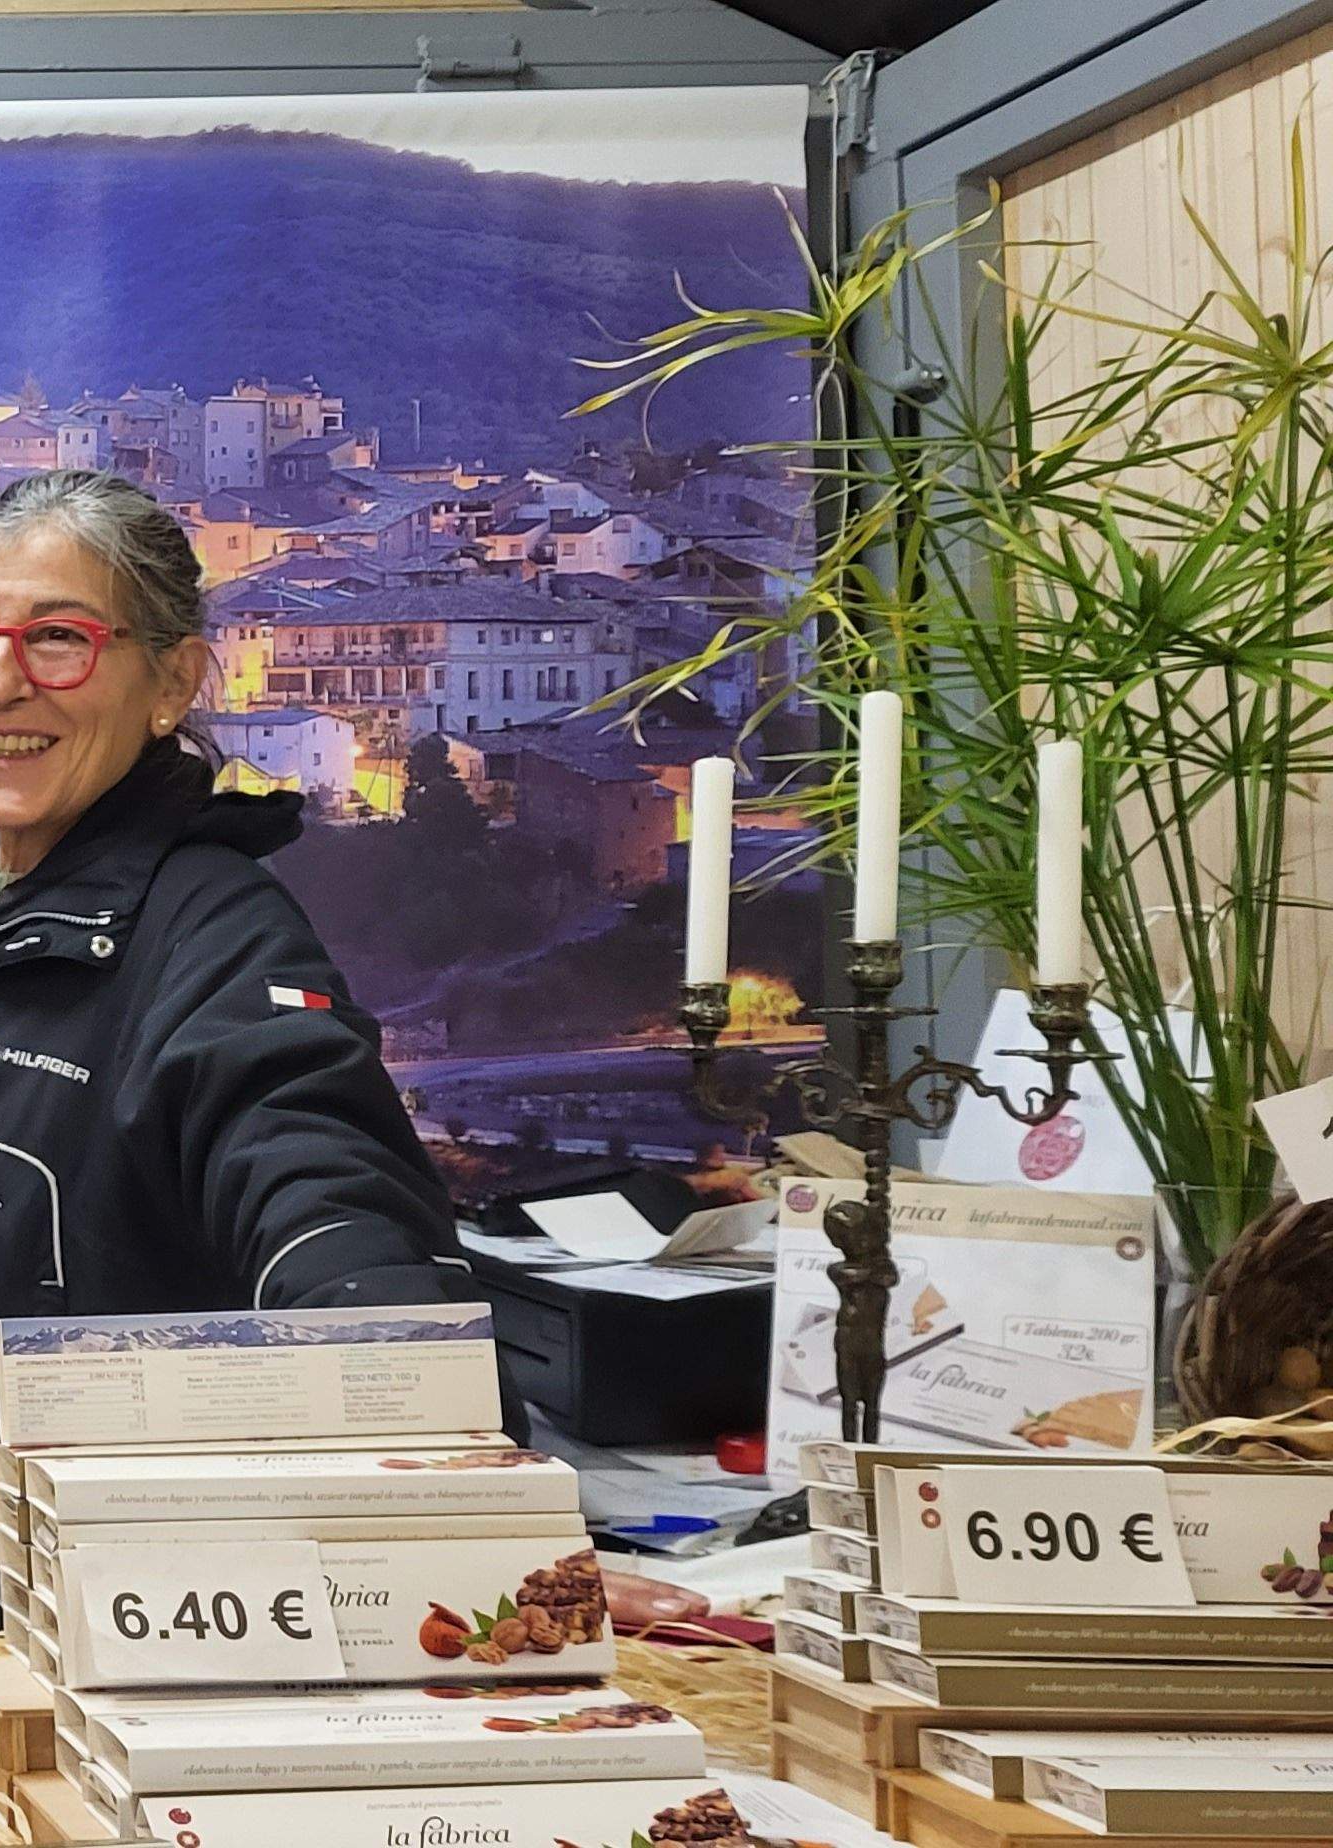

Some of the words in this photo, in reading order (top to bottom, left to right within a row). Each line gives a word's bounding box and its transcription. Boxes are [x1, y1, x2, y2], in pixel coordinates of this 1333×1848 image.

[1, 1047, 91, 1084] HILFIGER
[967, 1510, 1101, 1562] 6.90
[1119, 1512, 1164, 1563] €
[112, 1591, 248, 1640] 6.40
[269, 1589, 313, 1640] €
[387, 1824, 411, 1847] la
